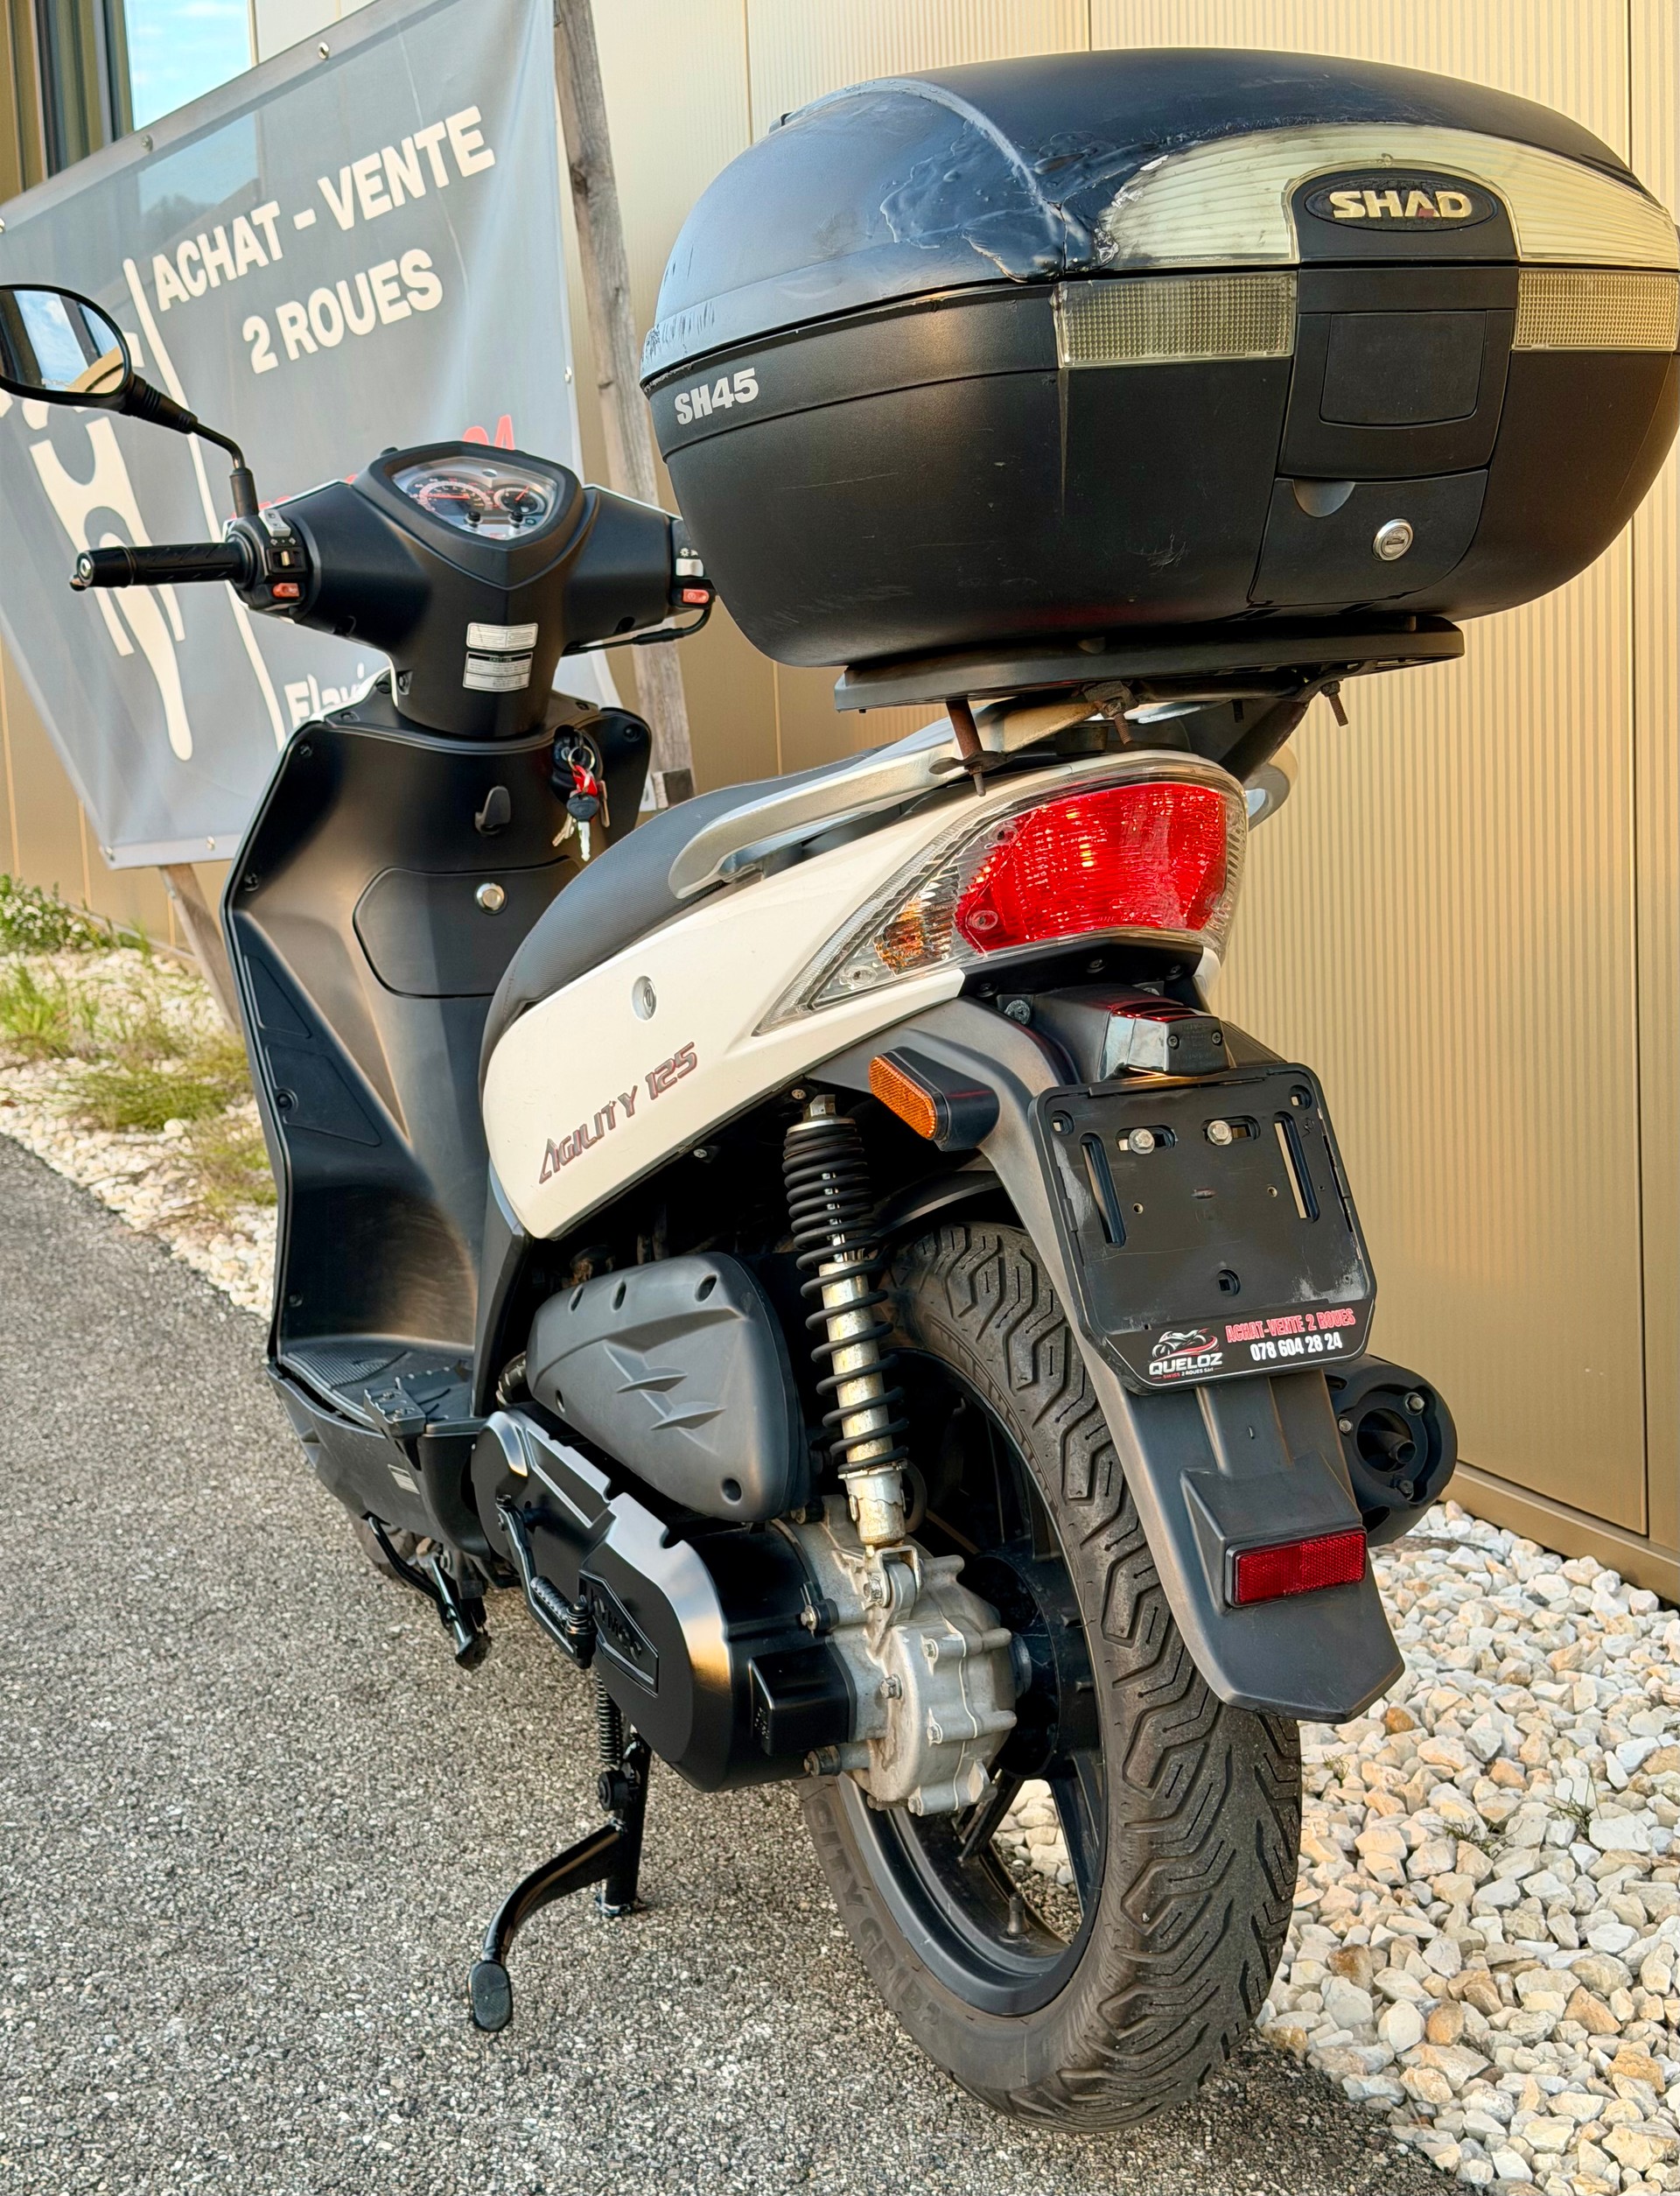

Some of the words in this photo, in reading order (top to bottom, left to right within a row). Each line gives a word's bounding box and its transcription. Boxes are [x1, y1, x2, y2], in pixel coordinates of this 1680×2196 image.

[152, 200, 284, 312] ACHAT
[293, 208, 317, 230] -
[317, 105, 496, 231] VENTE
[1329, 190, 1473, 219] SHAD
[242, 315, 279, 375] 2
[275, 249, 444, 361] ROUES
[675, 368, 760, 425] SH45
[538, 1084, 639, 1185] AGILITY
[645, 1041, 698, 1101] 125
[1225, 1315, 1306, 1343] ACHAT-VENTE
[1305, 1314, 1317, 1332] 2
[1316, 1308, 1356, 1330] ROUES
[1250, 1340, 1278, 1361] 078
[1278, 1337, 1305, 1357] 604
[1305, 1334, 1324, 1353] 28
[1324, 1331, 1343, 1351] 24
[1149, 1352, 1223, 1376] QUELOZ
